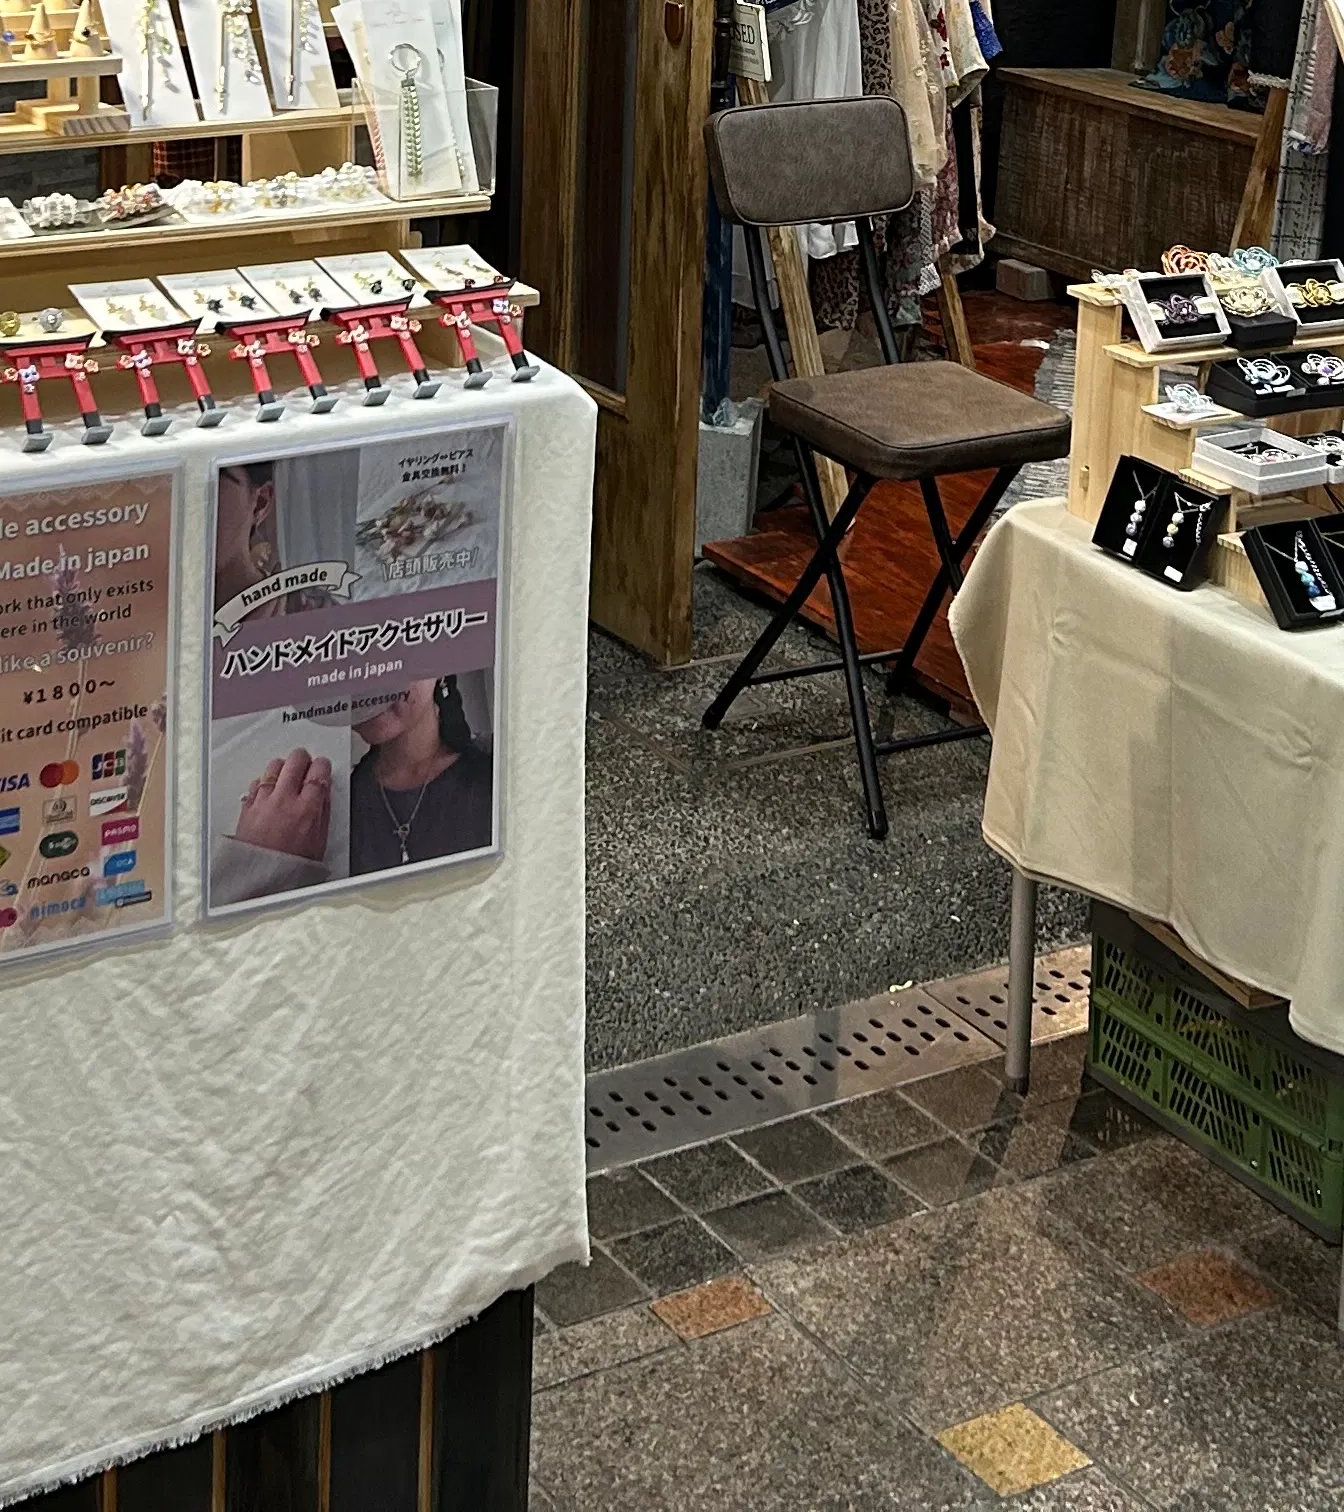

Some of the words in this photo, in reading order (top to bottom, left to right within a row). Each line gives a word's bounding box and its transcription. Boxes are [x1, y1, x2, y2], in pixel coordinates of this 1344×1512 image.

[25, 500, 150, 536] accessory
[58, 550, 81, 572] in
[83, 543, 150, 574] japan
[27, 592, 62, 612] that
[66, 586, 102, 610] only
[106, 578, 154, 597] exists
[241, 579, 281, 608] hand
[284, 567, 328, 589] made
[32, 619, 48, 634] in
[52, 612, 81, 631] the
[84, 605, 132, 626] world
[39, 652, 50, 669] a
[56, 631, 155, 665] souvenir?
[220, 608, 488, 679] ハンドメイドアクセサリー
[307, 668, 347, 688] made
[349, 665, 362, 679] in
[363, 659, 403, 681] japan
[16, 720, 53, 745] card
[57, 703, 148, 736] compatible
[282, 700, 348, 724] handmade
[351, 690, 411, 712] accessory
[92, 750, 127, 780] JCB
[27, 866, 91, 889] manaca
